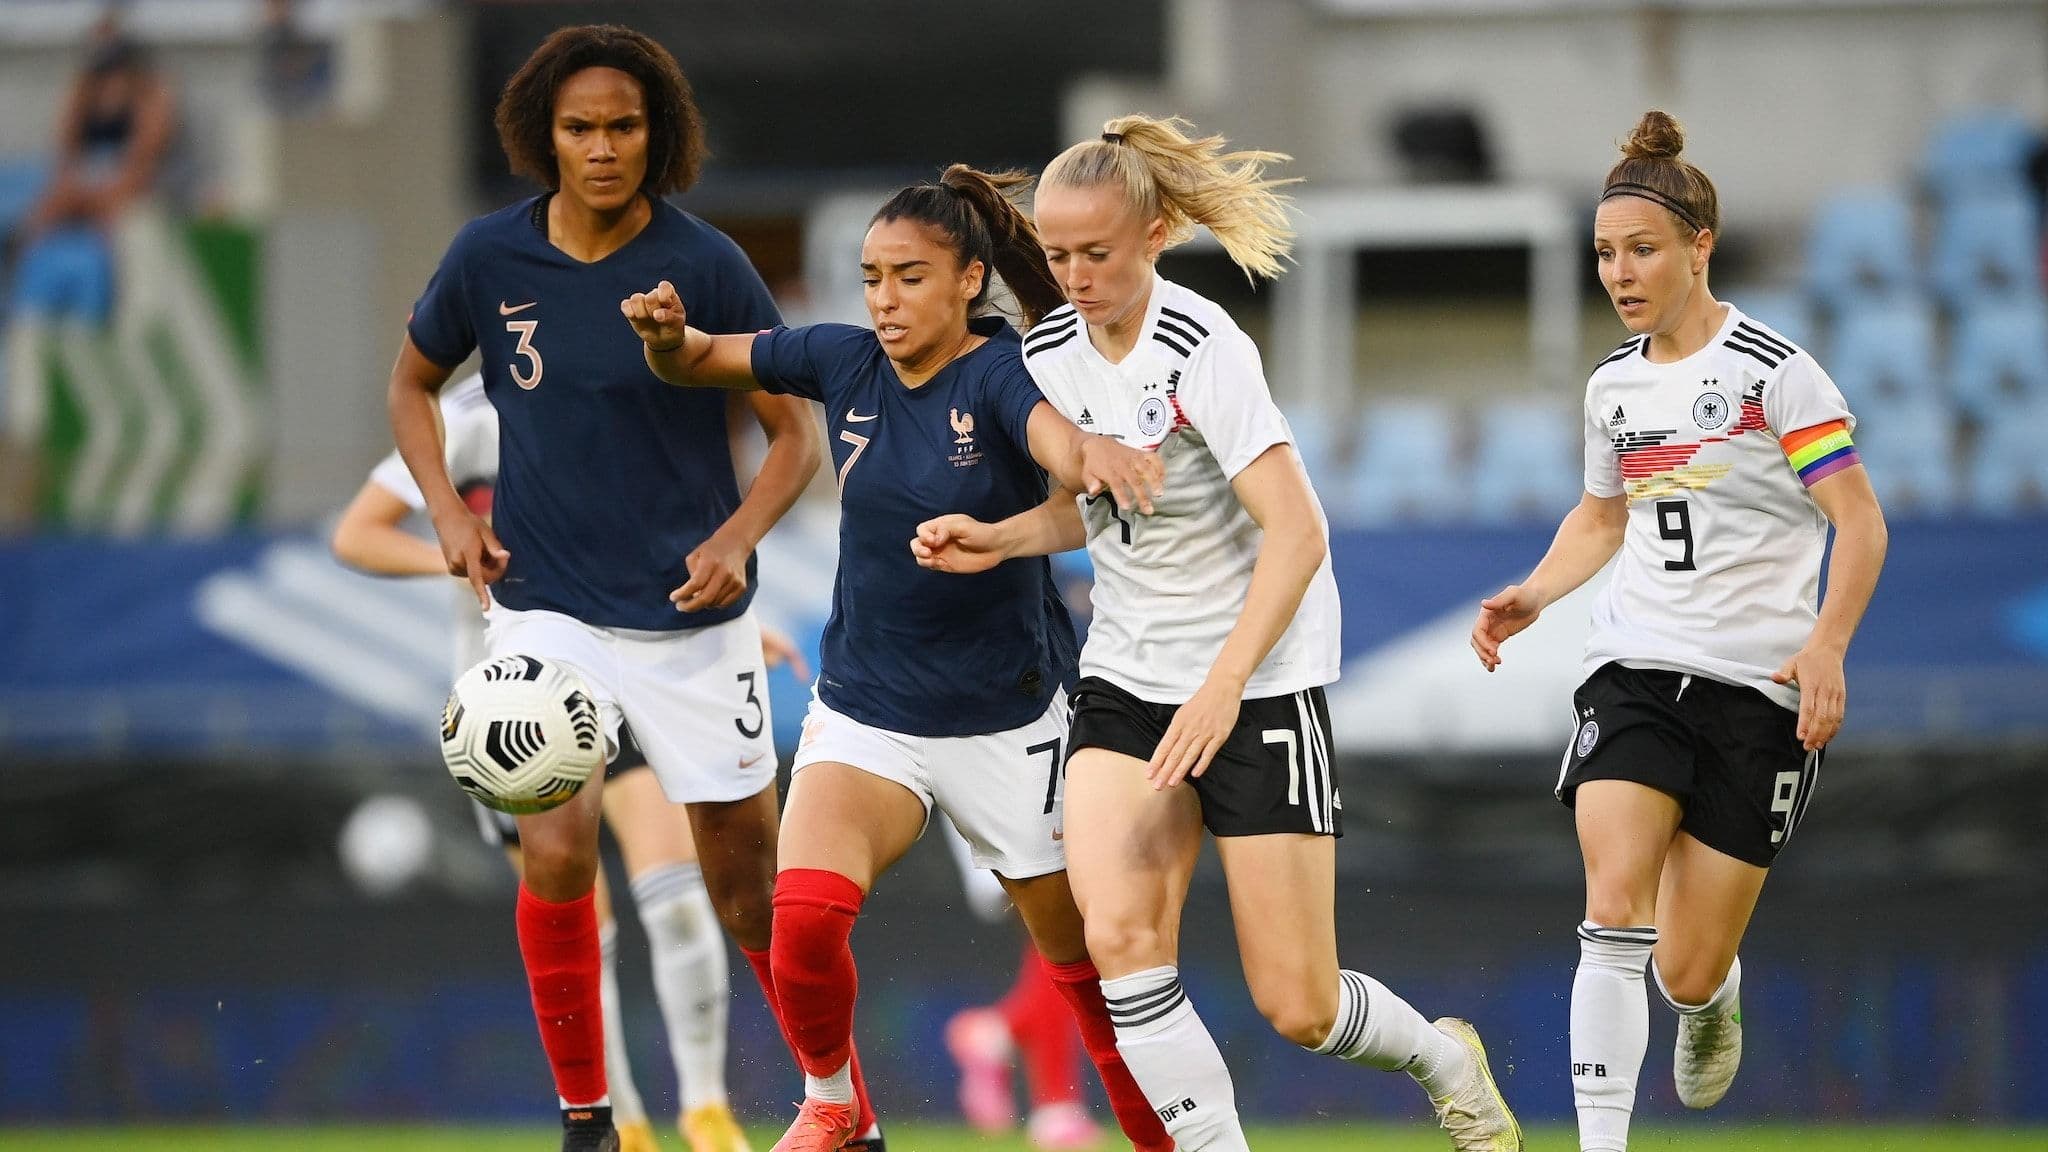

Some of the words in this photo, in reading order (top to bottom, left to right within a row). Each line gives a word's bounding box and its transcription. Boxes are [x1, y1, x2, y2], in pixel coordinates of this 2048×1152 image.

[506, 321, 543, 390] 3
[840, 430, 870, 500] 7
[1656, 500, 1697, 571] 9
[735, 671, 763, 739] 3
[1026, 737, 1061, 815] 7
[1262, 729, 1300, 806] 7
[1770, 771, 1801, 843] 9
